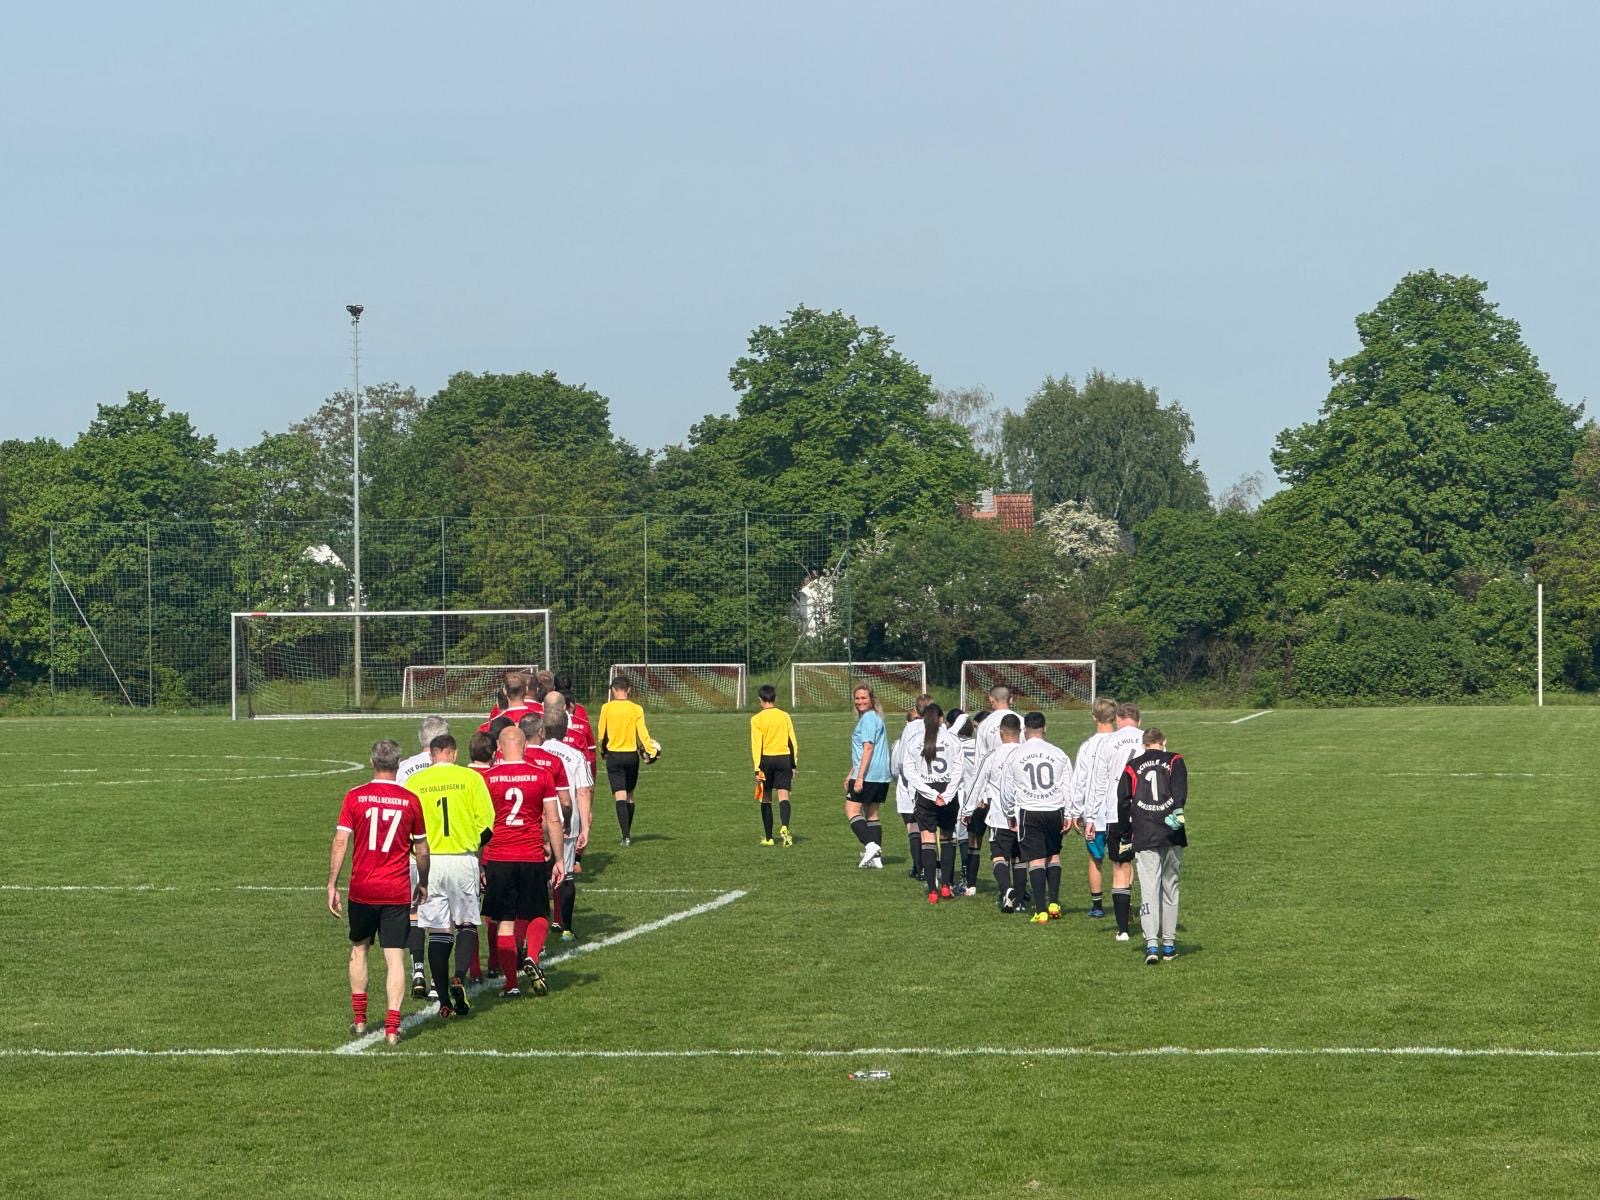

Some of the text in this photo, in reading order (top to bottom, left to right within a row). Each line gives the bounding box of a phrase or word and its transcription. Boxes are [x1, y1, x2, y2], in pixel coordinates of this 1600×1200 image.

[1114, 738, 1139, 750] SCHULE
[1020, 753, 1055, 764] SCHULE AM
[404, 762, 430, 776] TSV Dollb
[1137, 760, 1171, 775] SCHULE AM
[490, 775, 498, 783] TSV
[1023, 762, 1054, 790] 10
[428, 784, 460, 793] DOLLBERGEN
[1145, 770, 1158, 801] 1
[1023, 787, 1059, 799] WASSERWERK
[358, 795, 368, 803] TSV
[368, 795, 402, 806] DOLLBERGEN
[505, 787, 524, 826] 2
[1137, 796, 1174, 812] WASSERWERK
[436, 797, 450, 837] 1
[365, 806, 403, 853] 17
